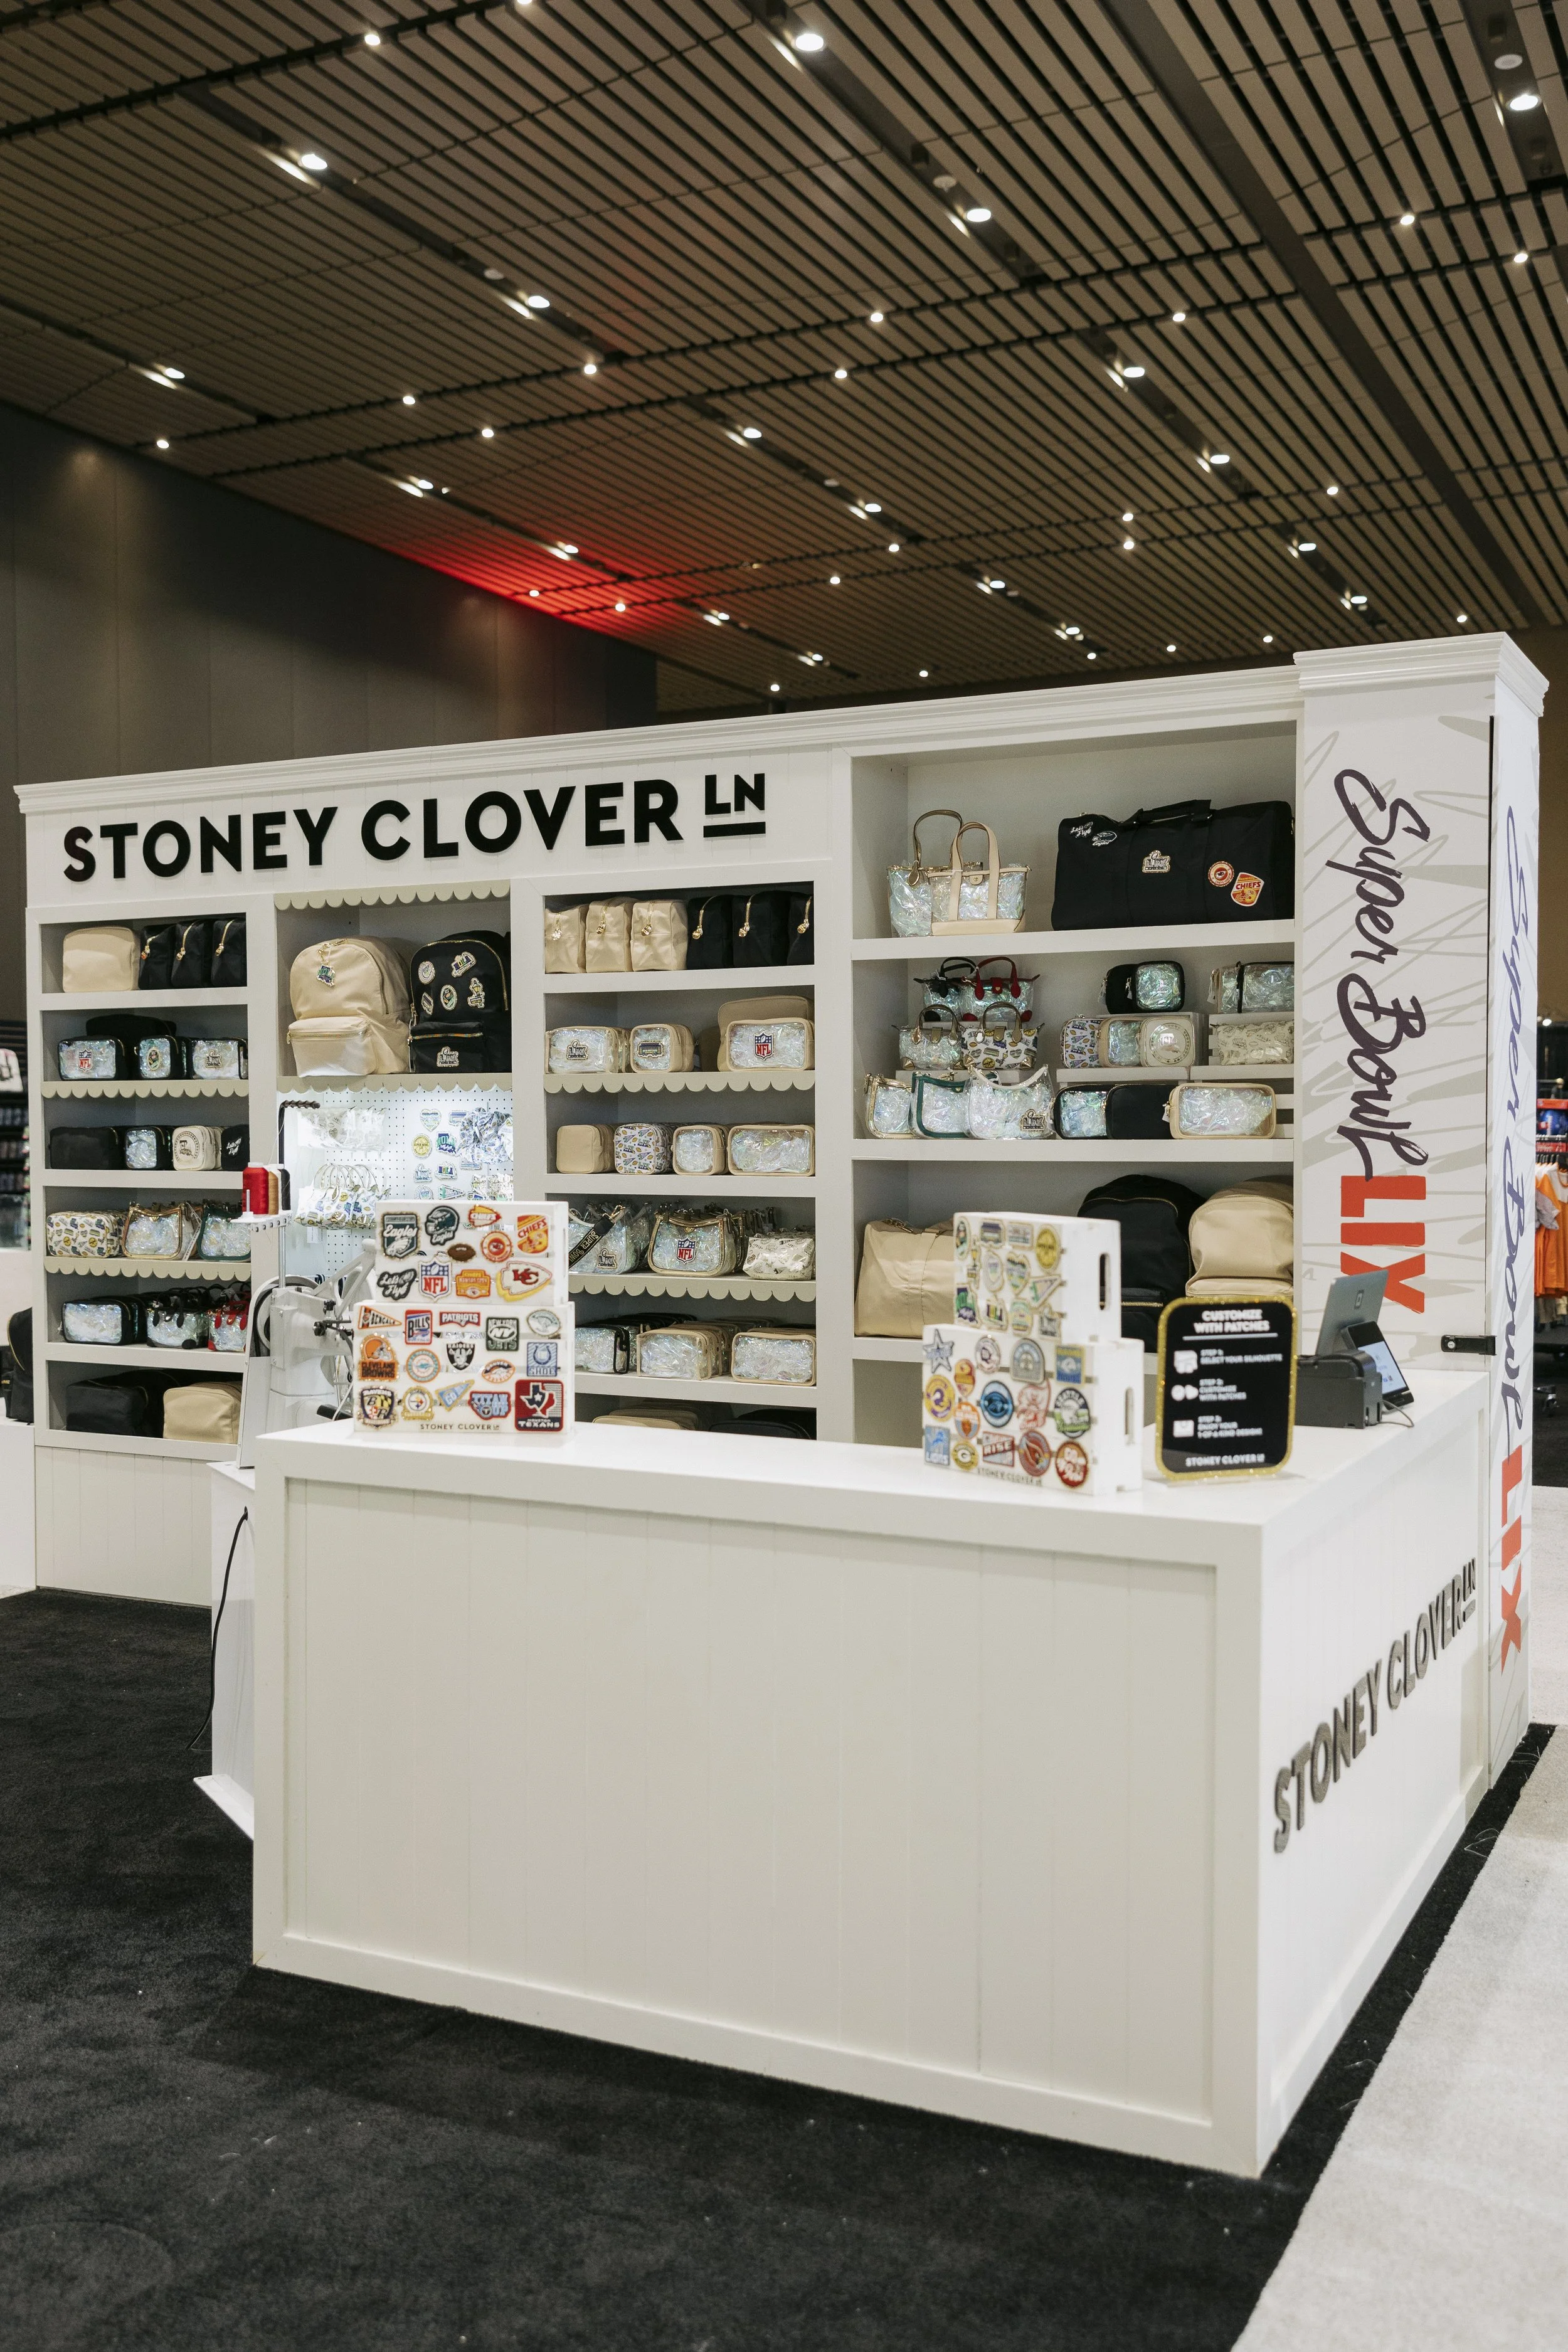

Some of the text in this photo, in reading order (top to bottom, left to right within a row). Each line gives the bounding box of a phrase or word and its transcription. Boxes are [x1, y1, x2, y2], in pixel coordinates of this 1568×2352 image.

[63, 773, 765, 882] STONEY CLOVER LN
[1236, 882, 1261, 890] CHIEFS
[1325, 769, 1430, 1314] Super Bowl LIX
[756, 1044, 771, 1056] NFL
[80, 1059, 91, 1068] NFL
[383, 1224, 418, 1240] Eagles
[517, 1217, 548, 1238] CHIEFS
[433, 1231, 453, 1243] Eagles
[580, 1231, 599, 1249] SUPER
[1501, 805, 1528, 1676] Super Bowl LIX
[678, 1249, 692, 1260] NFL
[512, 1268, 539, 1285] KC
[423, 1277, 447, 1294] NFL
[442, 1313, 479, 1323] PATRIOTS
[1202, 1309, 1263, 1322] CUSTOMIZE
[408, 1316, 430, 1338] BILLS
[1194, 1320, 1270, 1333] WITH PATCHES
[487, 1339, 517, 1350] JETS
[472, 1394, 508, 1405] TITAN
[983, 1441, 1013, 1456] RISE
[1185, 1456, 1221, 1467] STONEY
[1221, 1454, 1256, 1465] CLOVER
[1274, 1556, 1476, 1853] STONEY CLOVER LN
